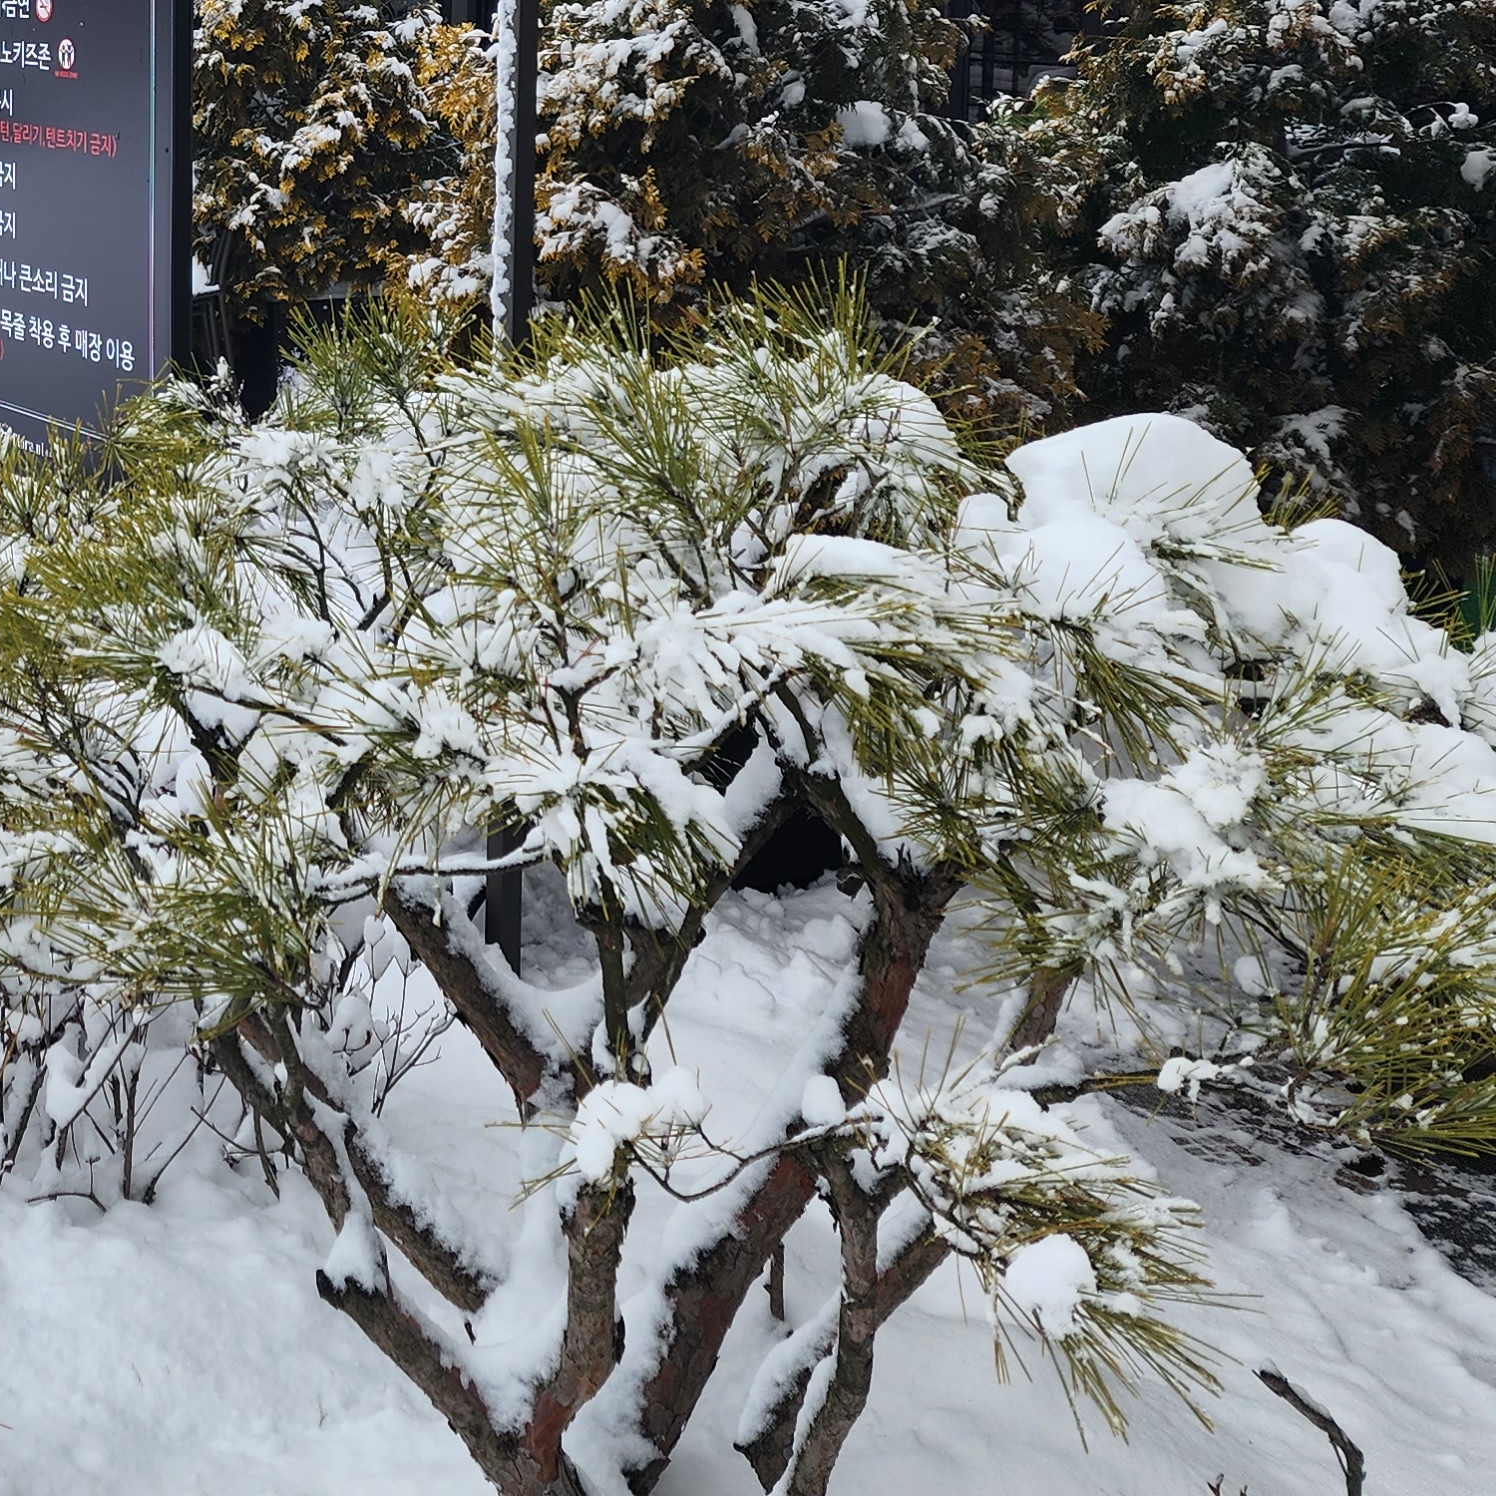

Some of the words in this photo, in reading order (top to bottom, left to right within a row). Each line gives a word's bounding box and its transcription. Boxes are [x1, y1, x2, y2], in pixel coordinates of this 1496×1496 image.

[0, 40, 52, 71] 노키즈존
[18, 263, 58, 300] 큰소리
[60, 273, 88, 307] 금지
[0, 309, 26, 341] 목줄
[28, 315, 55, 349] 착용
[57, 323, 72, 353] 후
[75, 329, 103, 362] 매장
[106, 337, 135, 372] 이용
